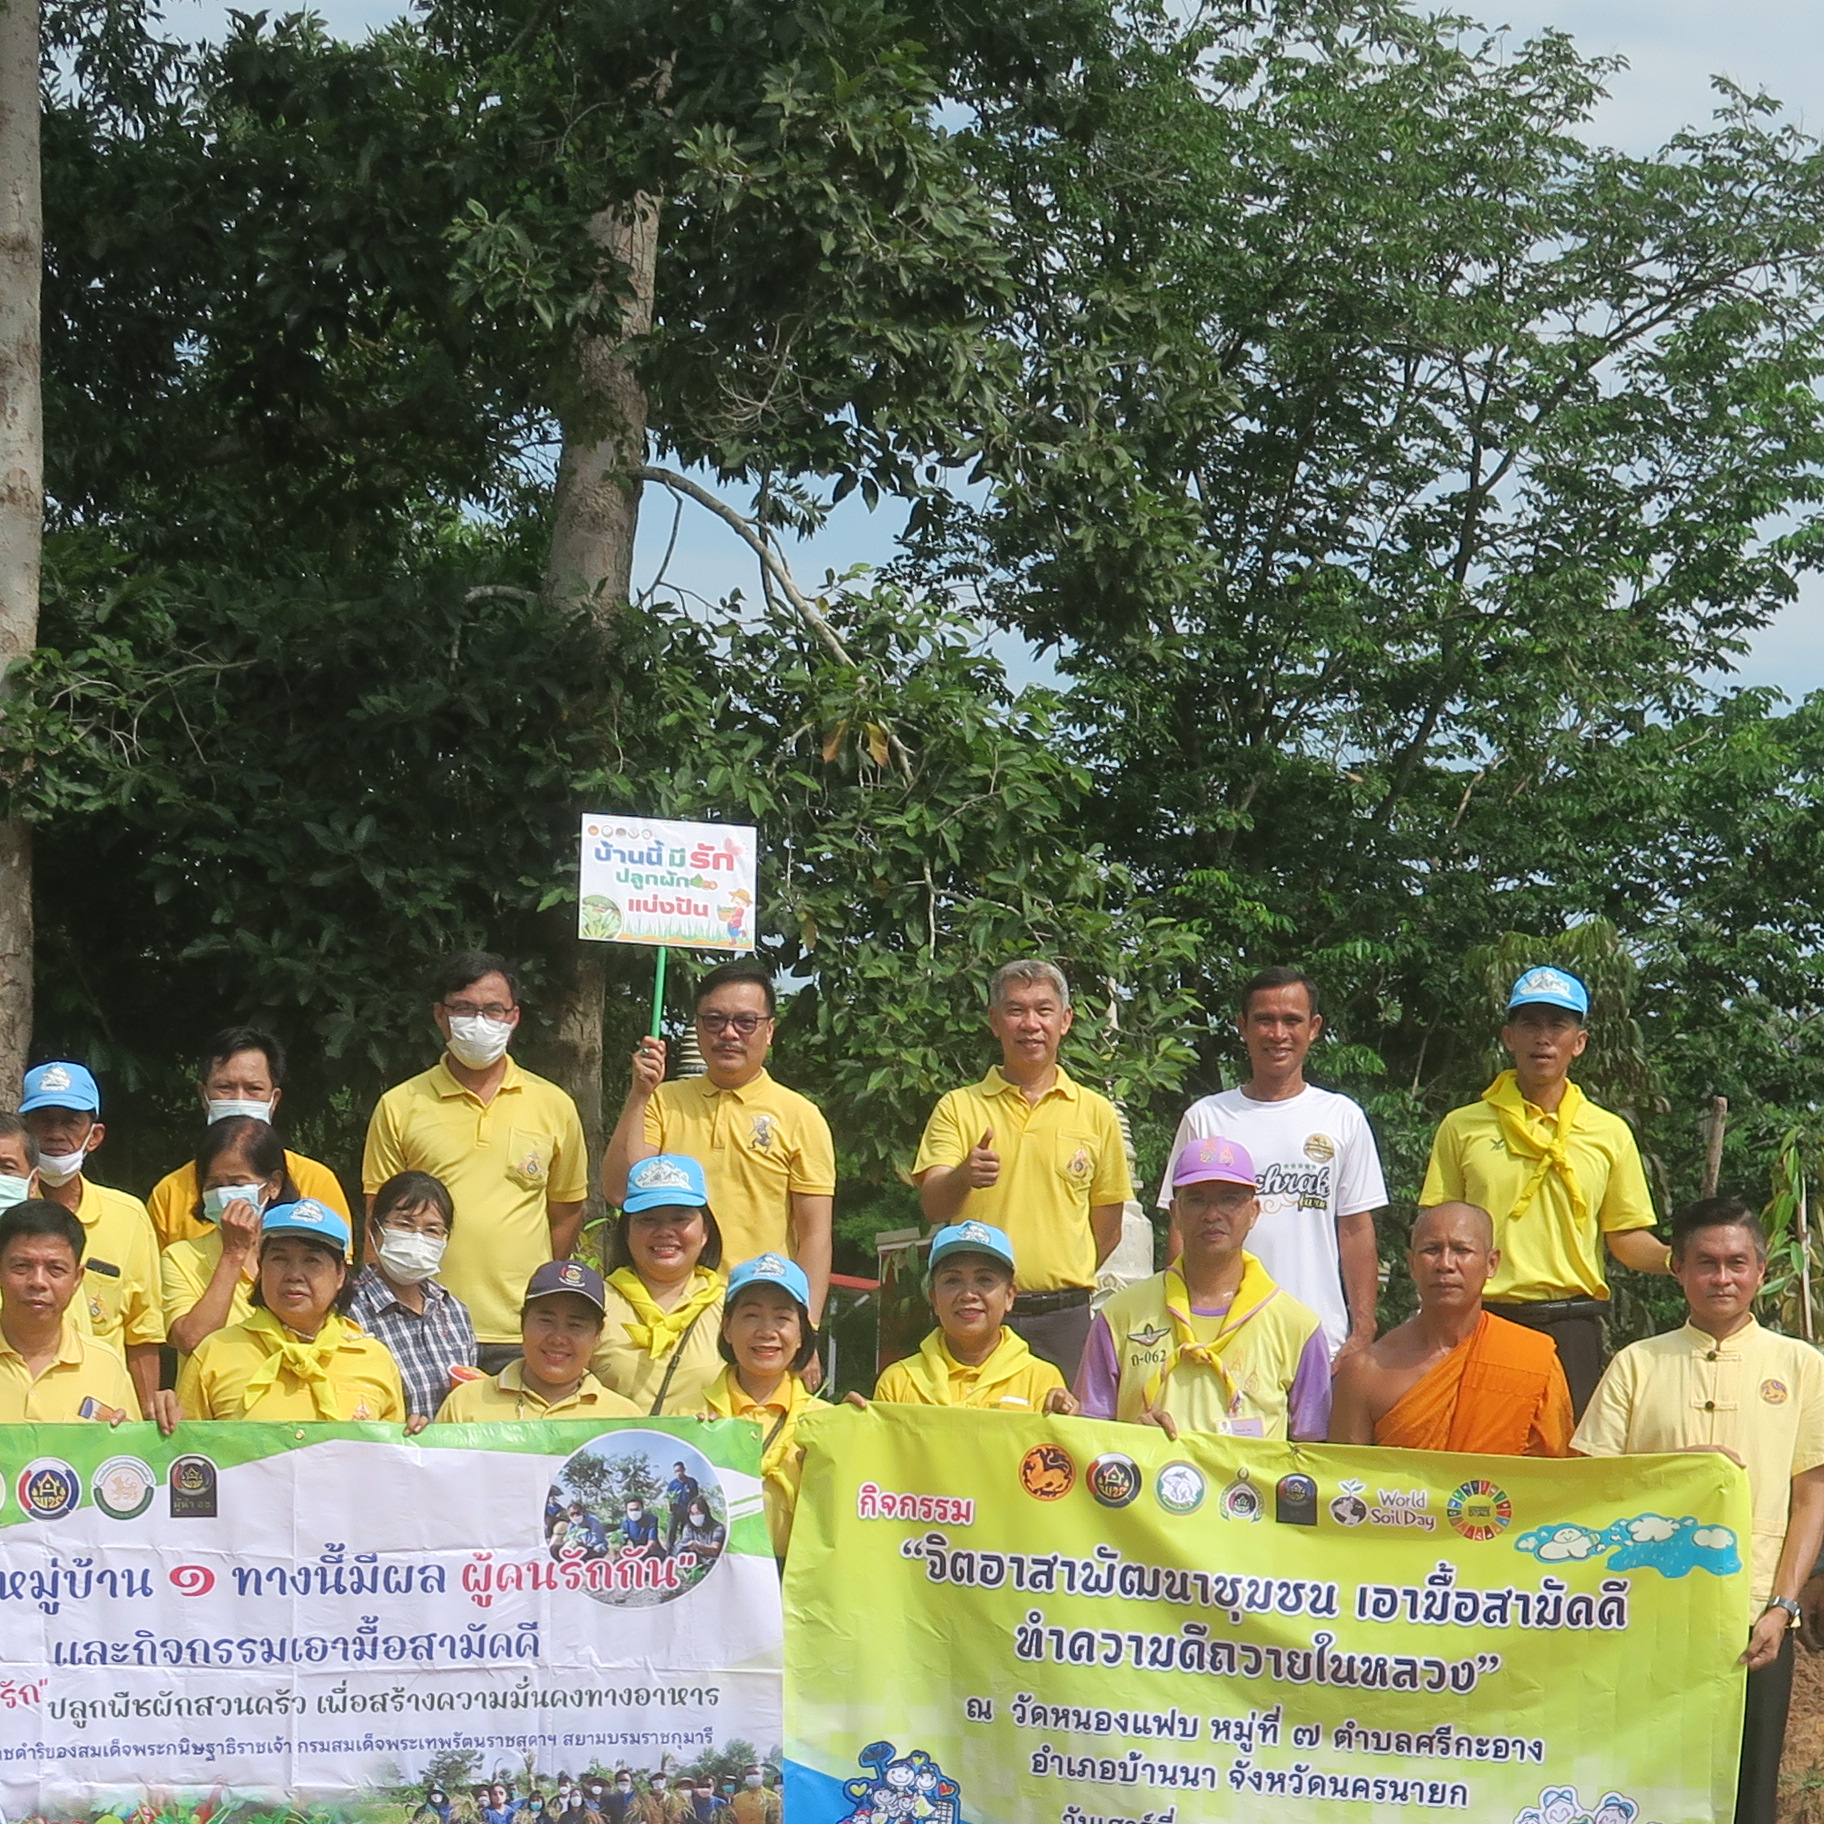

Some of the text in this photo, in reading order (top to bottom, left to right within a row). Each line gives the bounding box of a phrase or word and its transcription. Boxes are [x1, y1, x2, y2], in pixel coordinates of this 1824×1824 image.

[690, 843, 735, 871] รัก
[616, 868, 690, 890] ปลูกผัก
[628, 894, 709, 917] แบ่งปัน
[860, 1485, 972, 1523] กิจกรรม
[1379, 1491, 1426, 1508] World
[1371, 1509, 1436, 1530] Soil Day
[169, 1565, 215, 1597] ๑
[232, 1543, 446, 1597] ทางนี้มีผล
[1358, 1563, 1627, 1628] เอามื้อสามัคคี
[54, 1615, 541, 1667] และกิจกรรมเอามื้อสามัคคี
[48, 1690, 306, 1729] ปลูกพืชผักสวนครัว
[317, 1676, 719, 1714] เพื่อสร้างความมั่นคงทางอาหาร
[563, 1726, 714, 1750] สยามบรมราชกุมารี
[966, 1696, 1543, 1762] ณ วัดหนองแฟบ หมู่ที่ ๗ ตำบลศรีกะอาง
[1031, 1745, 1468, 1807] อำเภอบ้านนา จังหวัดนครนายก
